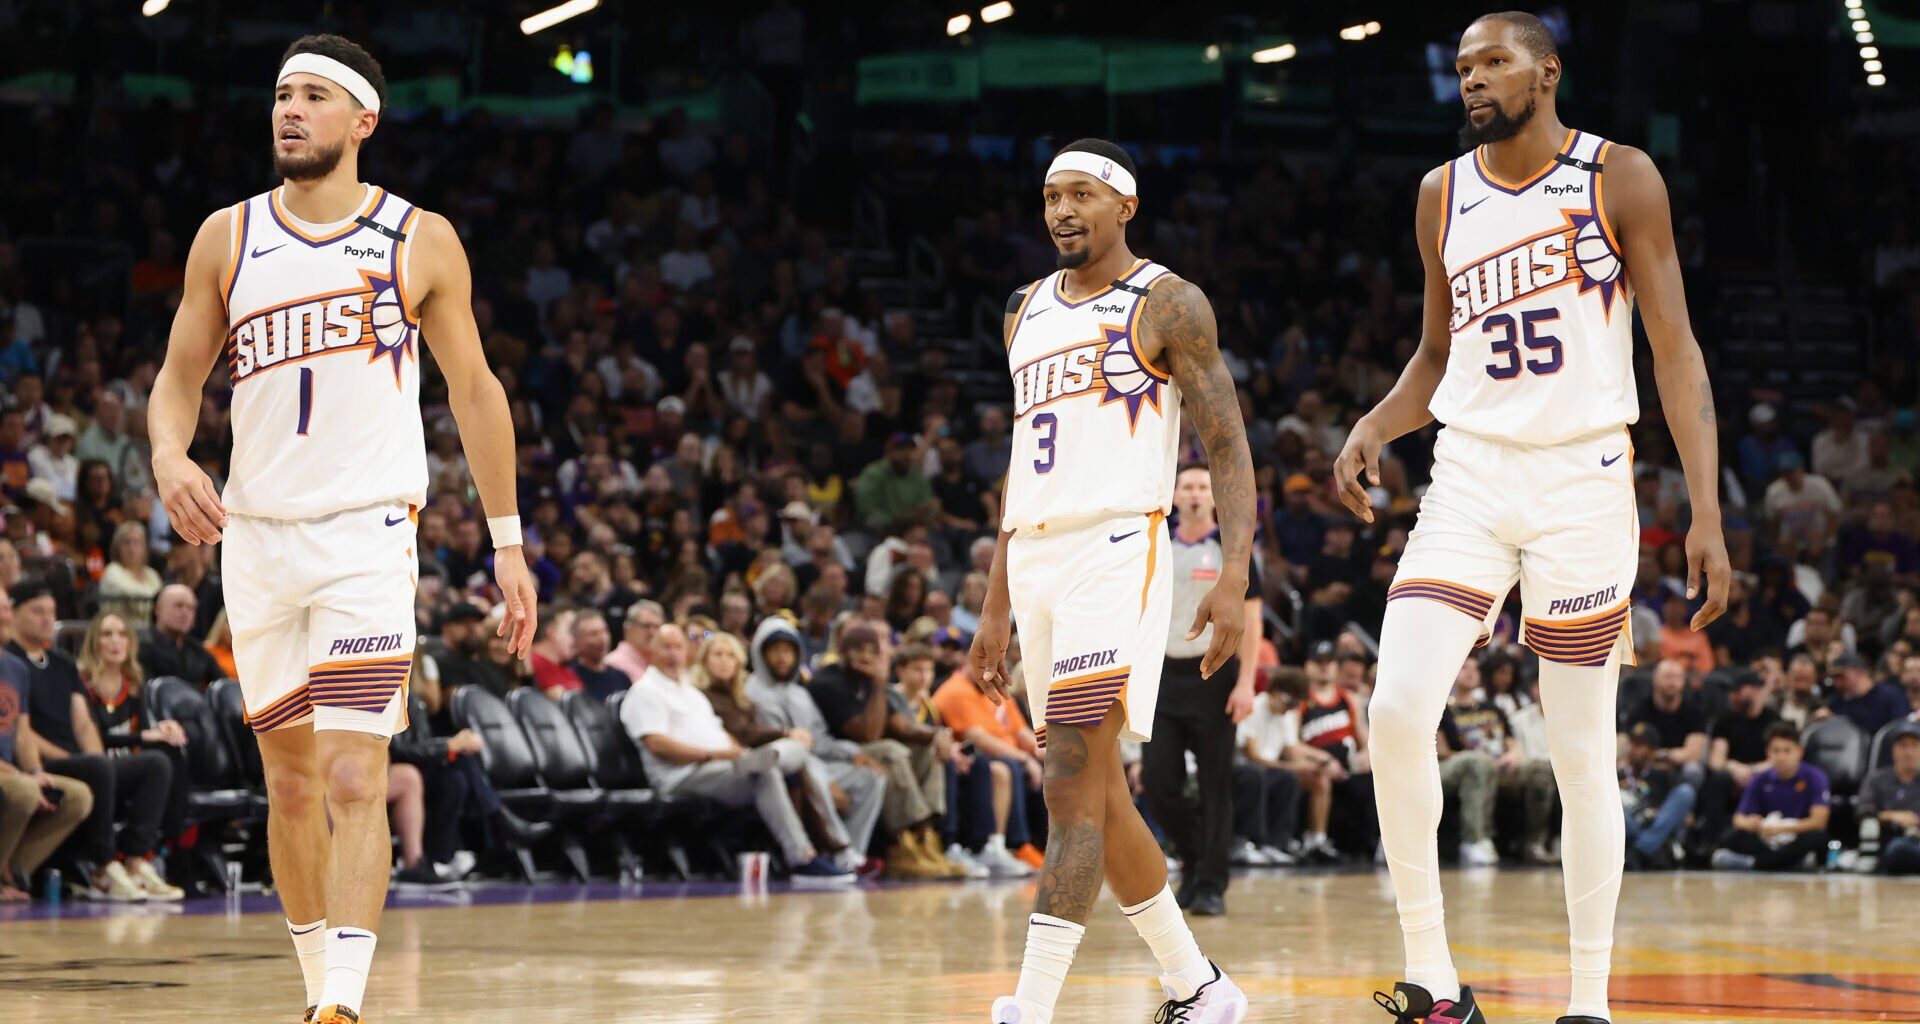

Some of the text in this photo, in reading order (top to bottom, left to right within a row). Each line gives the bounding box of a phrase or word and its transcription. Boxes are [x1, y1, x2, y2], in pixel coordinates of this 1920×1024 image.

[1575, 160, 1583, 169] AL
[1544, 184, 1583, 196] PayPal
[376, 224, 385, 234] AL
[344, 245, 385, 260] PayPal
[1451, 234, 1567, 331] SUNS
[1091, 303, 1125, 315] PayPal
[236, 296, 365, 378] SUNS
[1482, 307, 1564, 381] 35
[1014, 346, 1098, 416] UNS
[296, 366, 314, 437] 1
[1032, 412, 1058, 474] 3
[1548, 583, 1618, 615] PHOENIX
[329, 632, 403, 656] PHOENIX
[1052, 648, 1118, 678] PHOENIX
